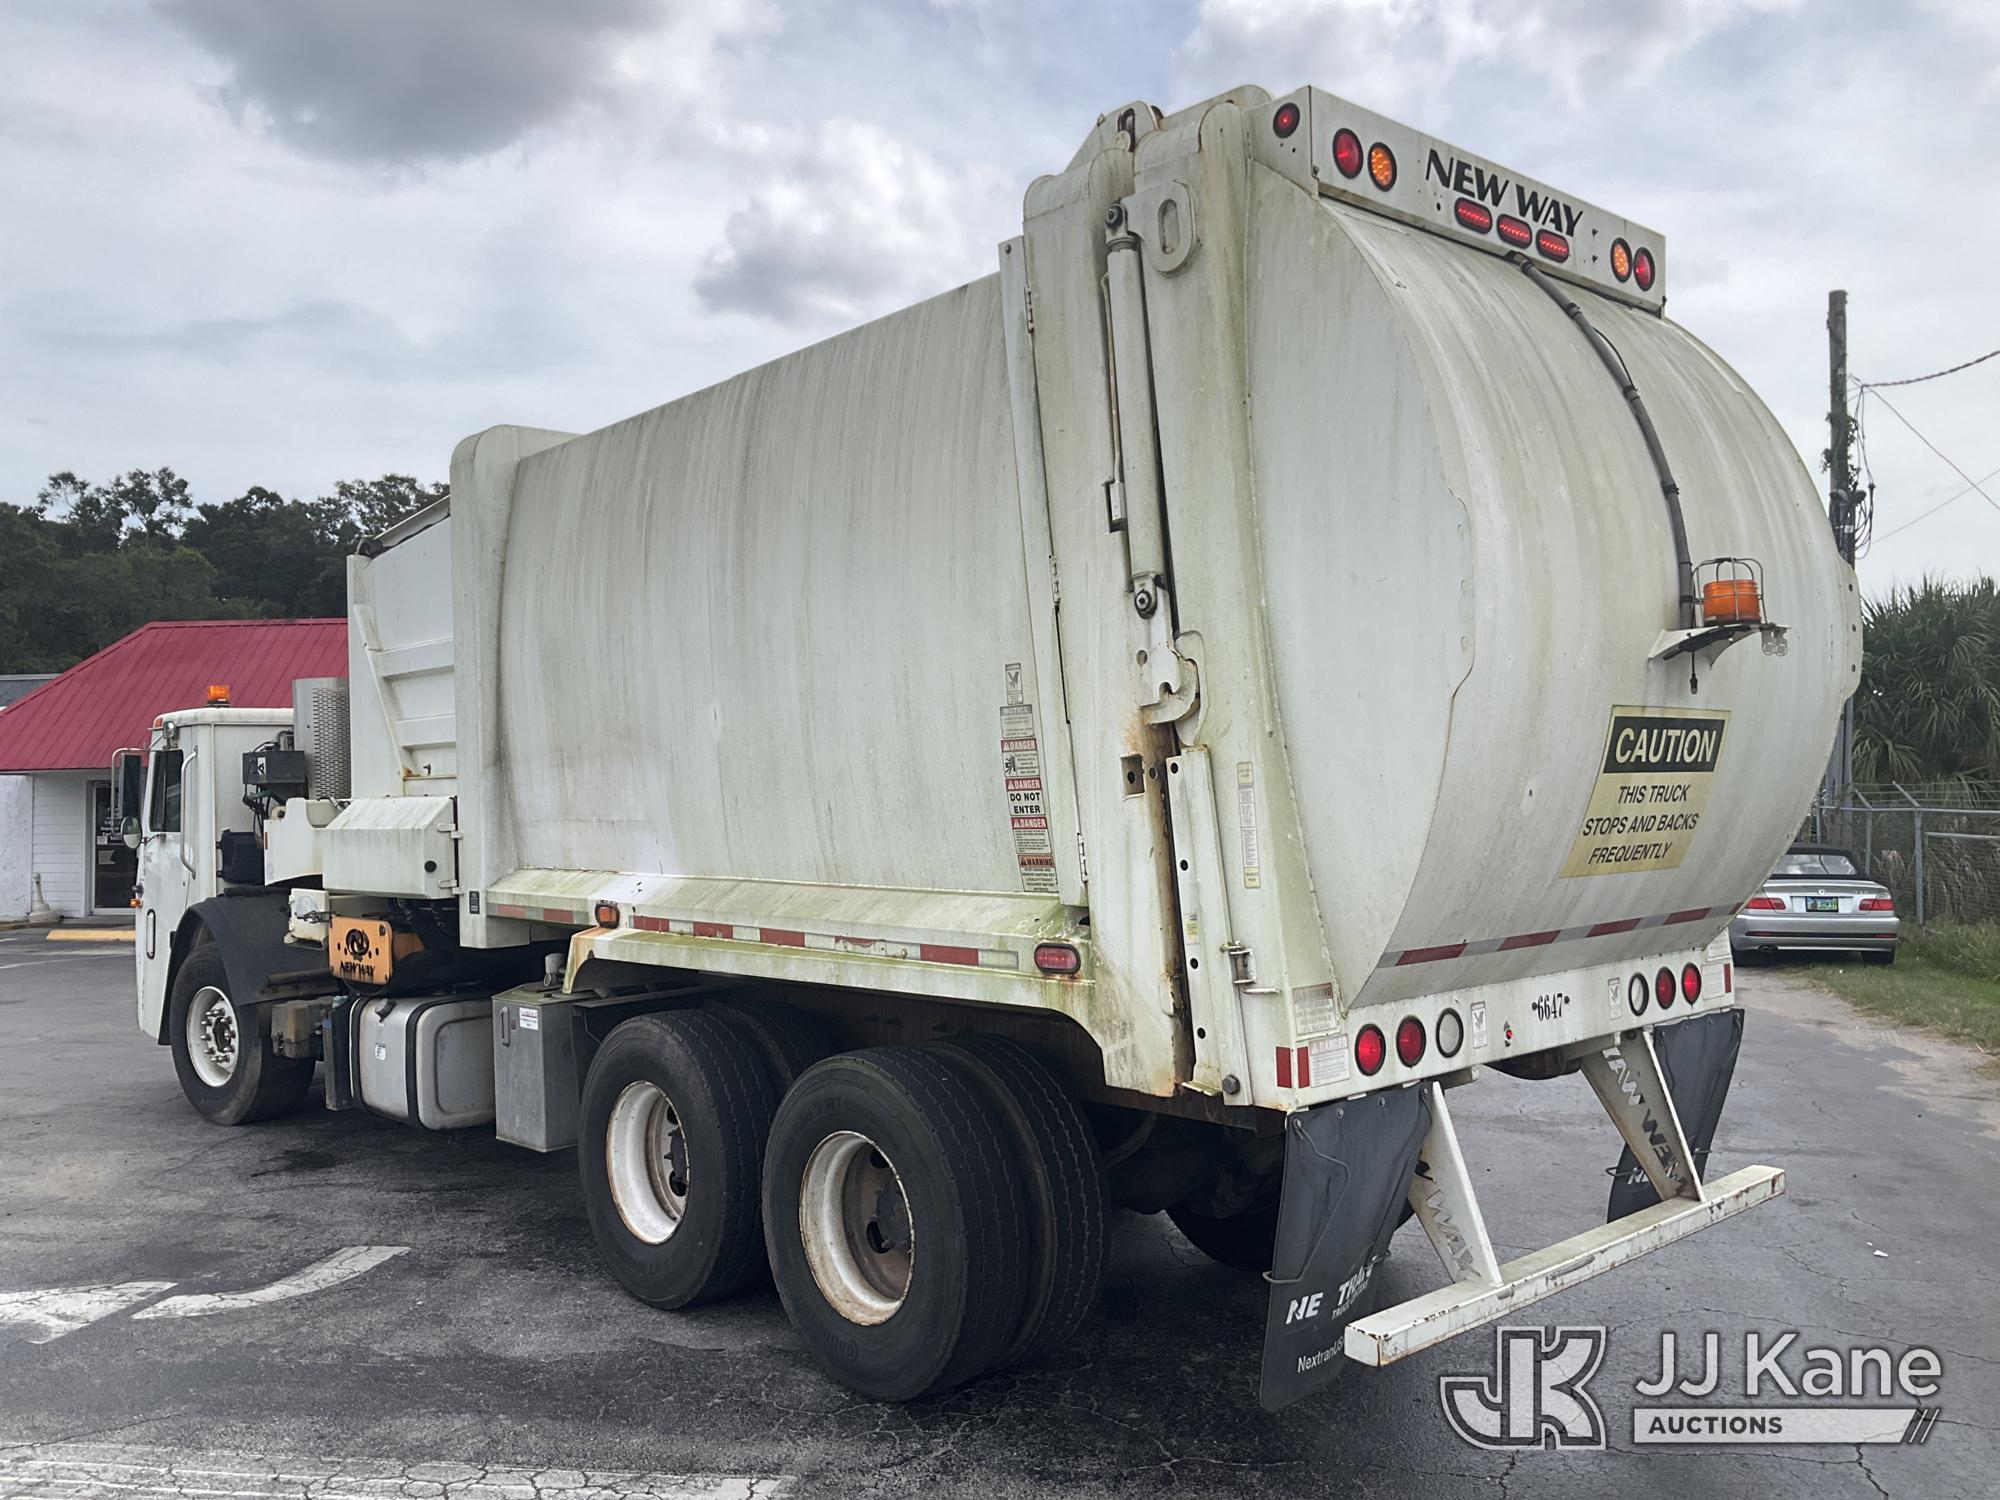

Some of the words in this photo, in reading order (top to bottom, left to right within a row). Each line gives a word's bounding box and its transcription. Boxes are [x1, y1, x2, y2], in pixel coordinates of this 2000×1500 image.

[1425, 148, 1509, 207] NEW
[1515, 183, 1583, 237] WAY
[1010, 740, 1036, 751] DANGER
[1615, 727, 1716, 763] CAUTION
[1014, 779, 1040, 790] DANGER
[1010, 793, 1022, 802] DO
[1024, 792, 1041, 801] NOT
[1618, 785, 1647, 804] THIS
[1649, 784, 1692, 802] TRUCK
[1014, 805, 1041, 814] ENTER
[1020, 818, 1047, 829] DANGER
[1582, 816, 1628, 837] STOPS
[1627, 815, 1657, 834] AND
[1657, 813, 1699, 830] BACKS
[1588, 842, 1673, 865] FREQUENTLY
[1027, 858, 1054, 867] WARNING
[1537, 993, 1563, 1021] 6647
[1319, 1035, 1348, 1052] DANGER
